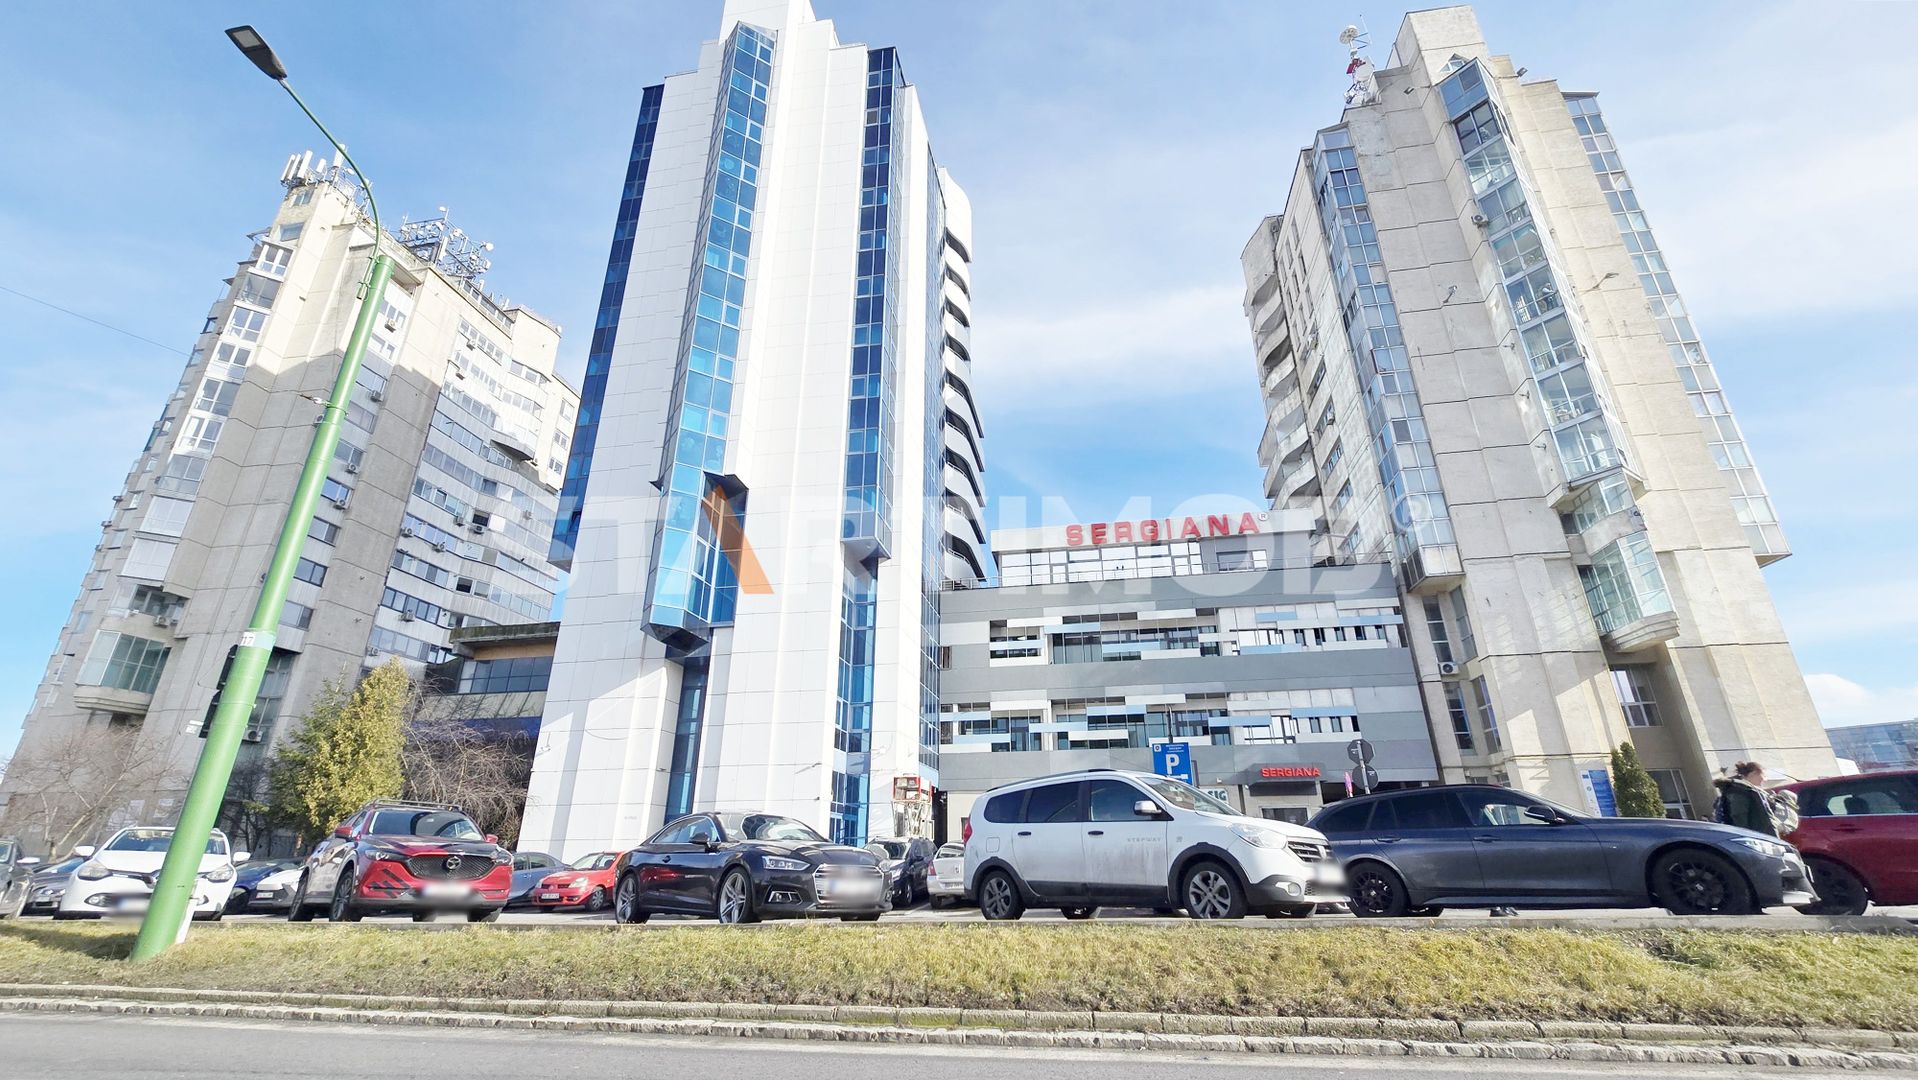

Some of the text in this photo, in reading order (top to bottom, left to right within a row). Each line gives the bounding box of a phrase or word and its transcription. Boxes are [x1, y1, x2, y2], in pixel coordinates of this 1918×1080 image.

[1066, 512, 1261, 546] SERGIANA
[1165, 753, 1180, 775] P
[1261, 766, 1322, 778] SERGIANA
